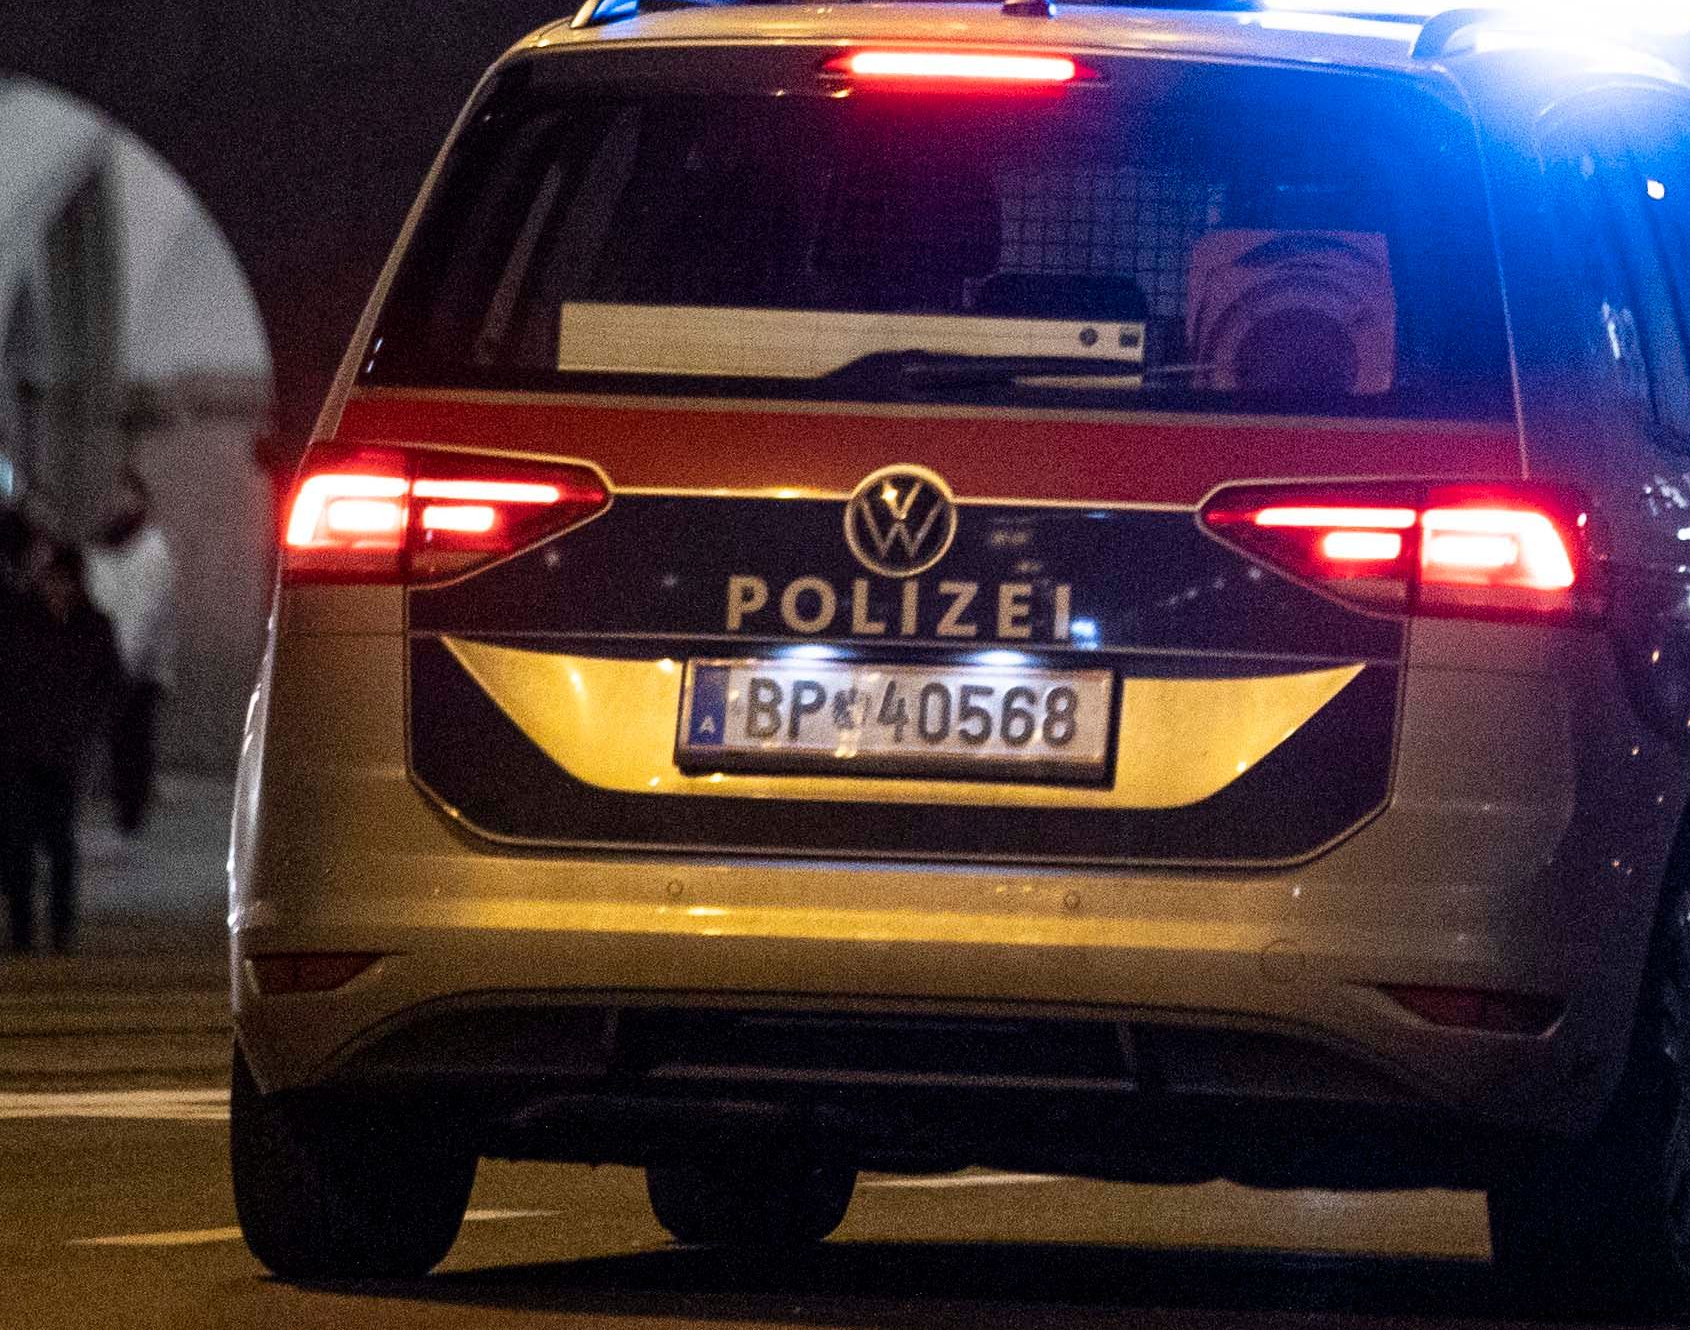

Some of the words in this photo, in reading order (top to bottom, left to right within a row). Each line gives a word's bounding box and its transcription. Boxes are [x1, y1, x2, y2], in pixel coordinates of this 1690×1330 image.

[726, 575, 1071, 640] POLIZEI
[699, 714, 717, 735] A
[745, 677, 829, 742] BP
[876, 680, 1079, 746] 40568
